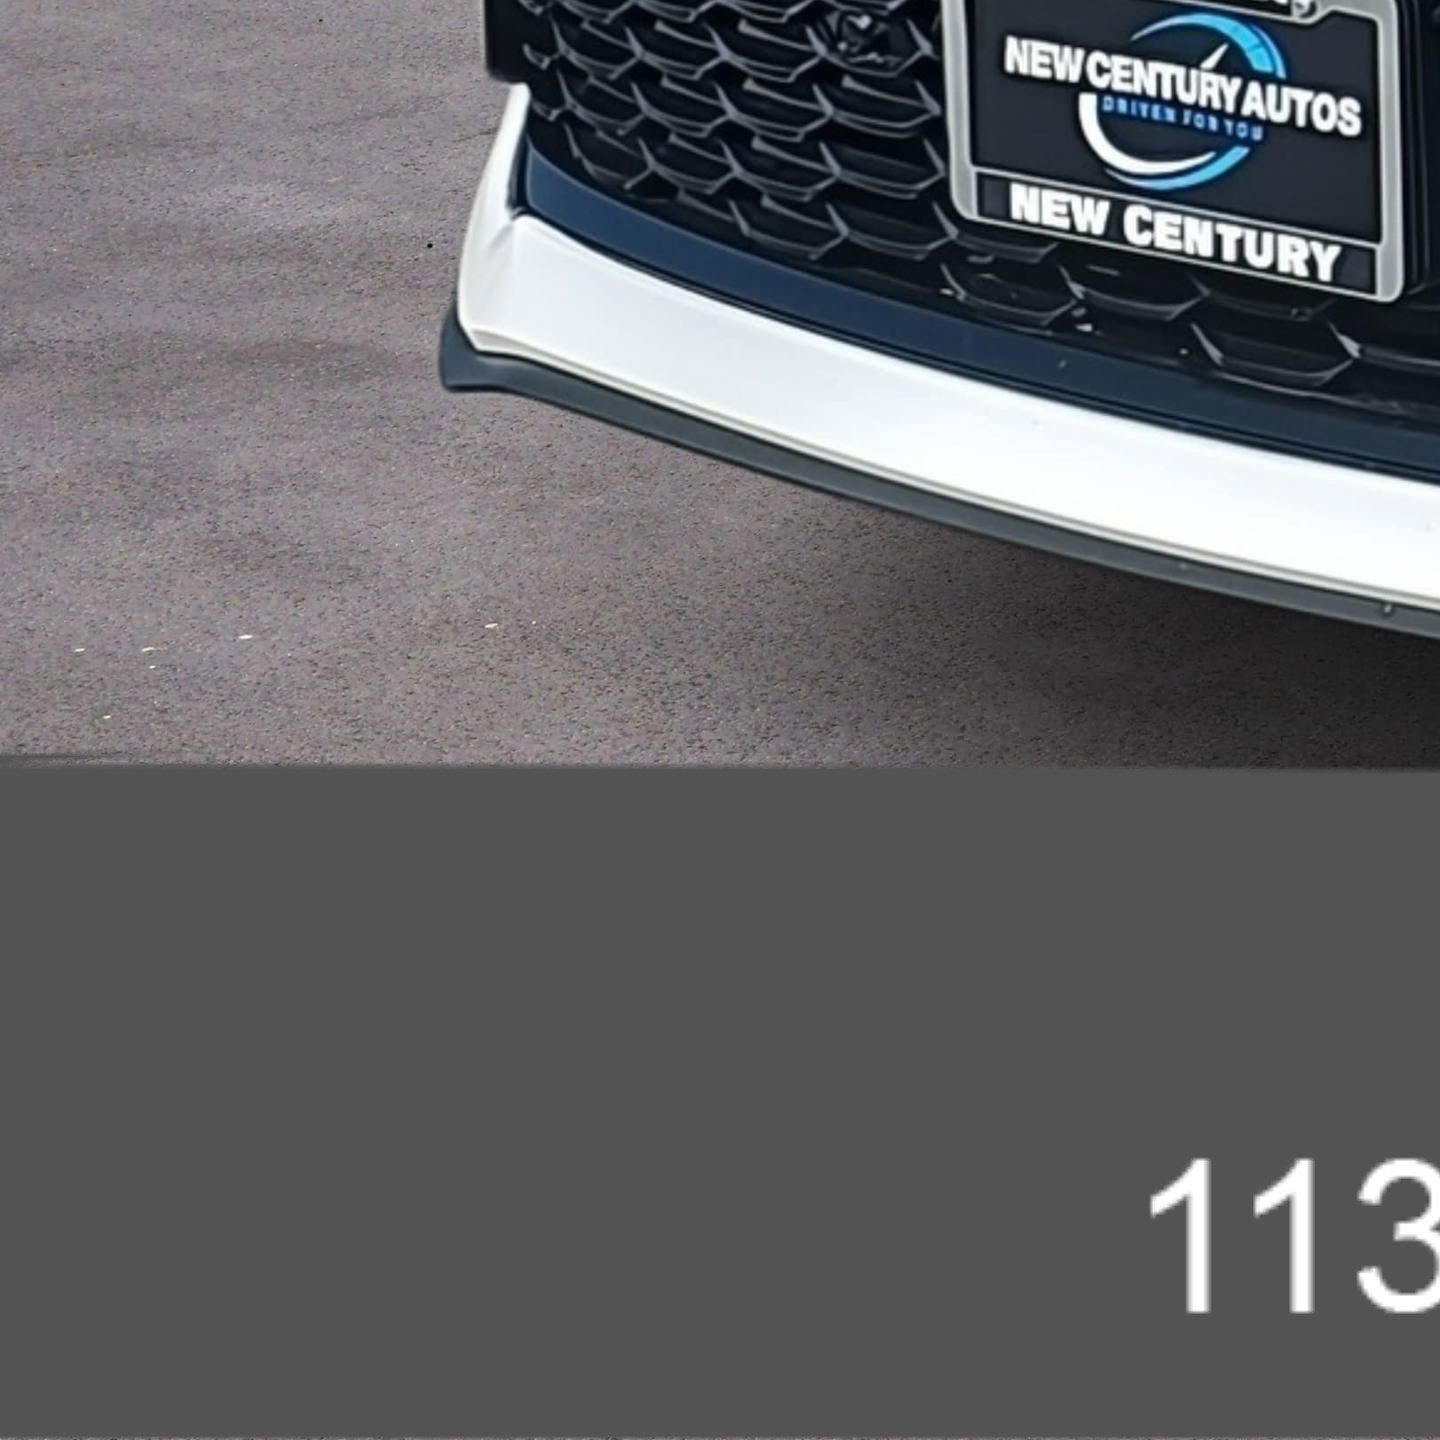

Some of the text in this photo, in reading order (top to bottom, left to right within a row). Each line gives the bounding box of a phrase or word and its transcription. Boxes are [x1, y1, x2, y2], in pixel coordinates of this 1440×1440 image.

[1004, 36, 1363, 137] NEW CENTURY AUTOS
[1101, 94, 1177, 124] DRIVEN
[1223, 116, 1265, 141] YOU
[1009, 182, 1343, 282] NEW CENTURY
